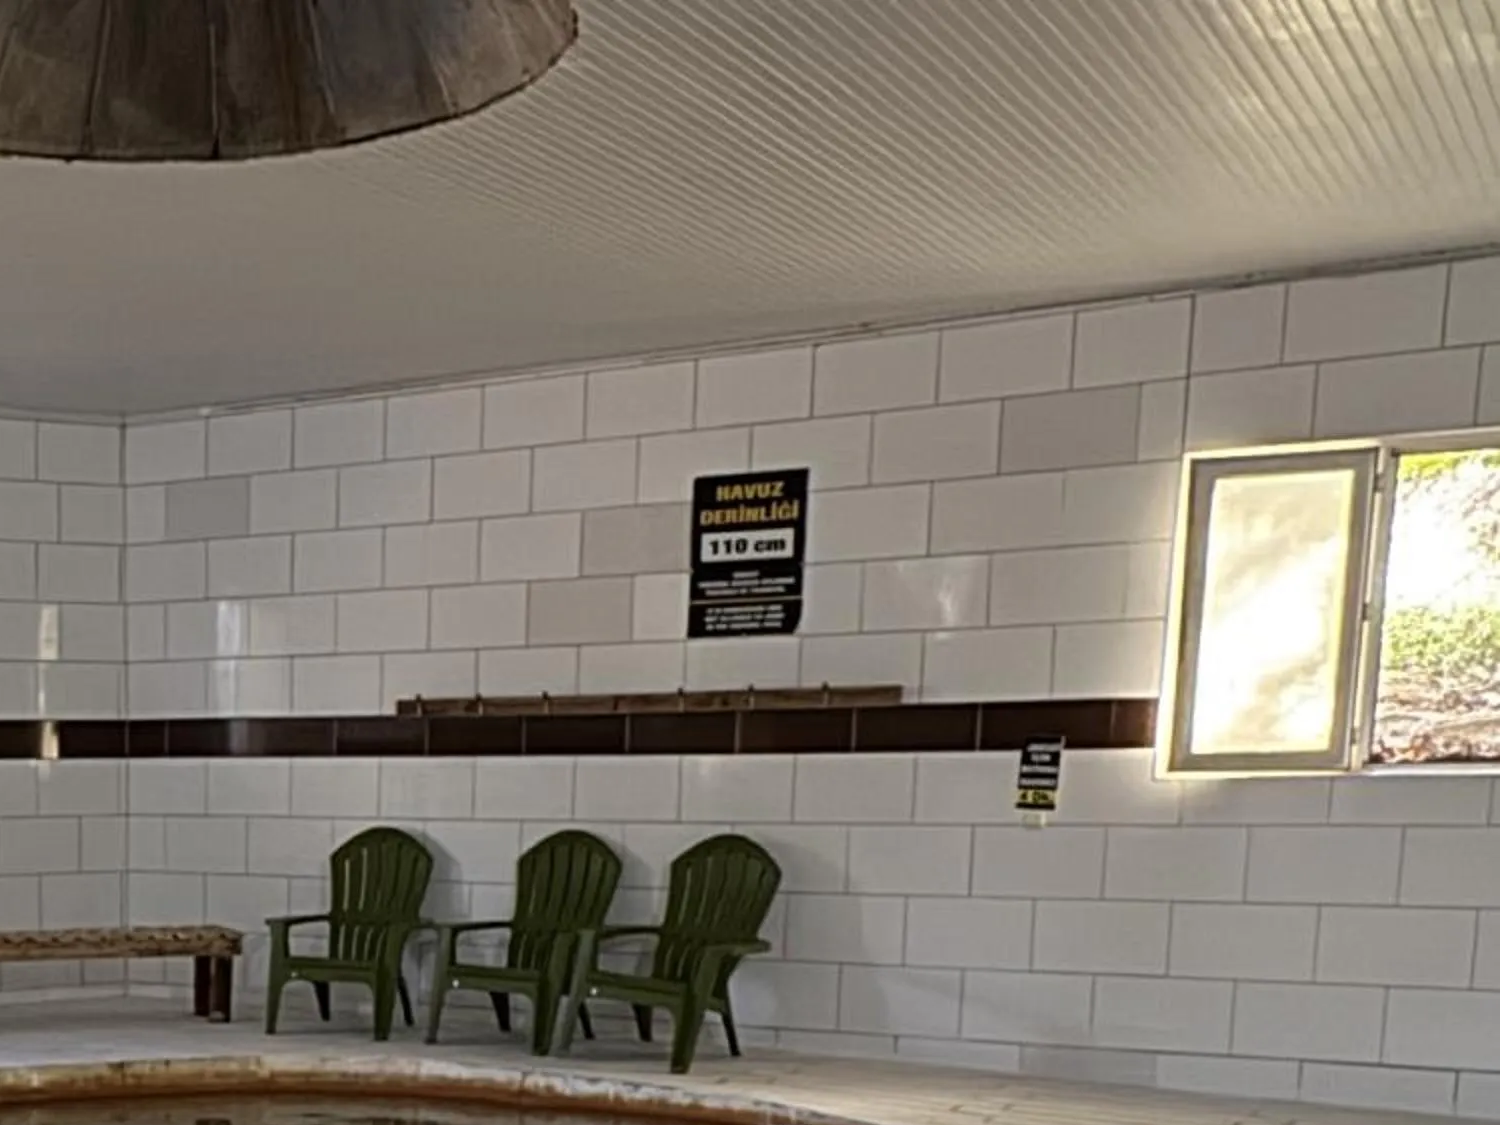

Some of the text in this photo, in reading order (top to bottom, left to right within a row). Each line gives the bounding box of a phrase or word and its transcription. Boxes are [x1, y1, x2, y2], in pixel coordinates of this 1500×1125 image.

[716, 482, 785, 501] HAVUZ
[700, 499, 800, 525] DERİNLİĞİ
[709, 538, 786, 555] 110 cm
